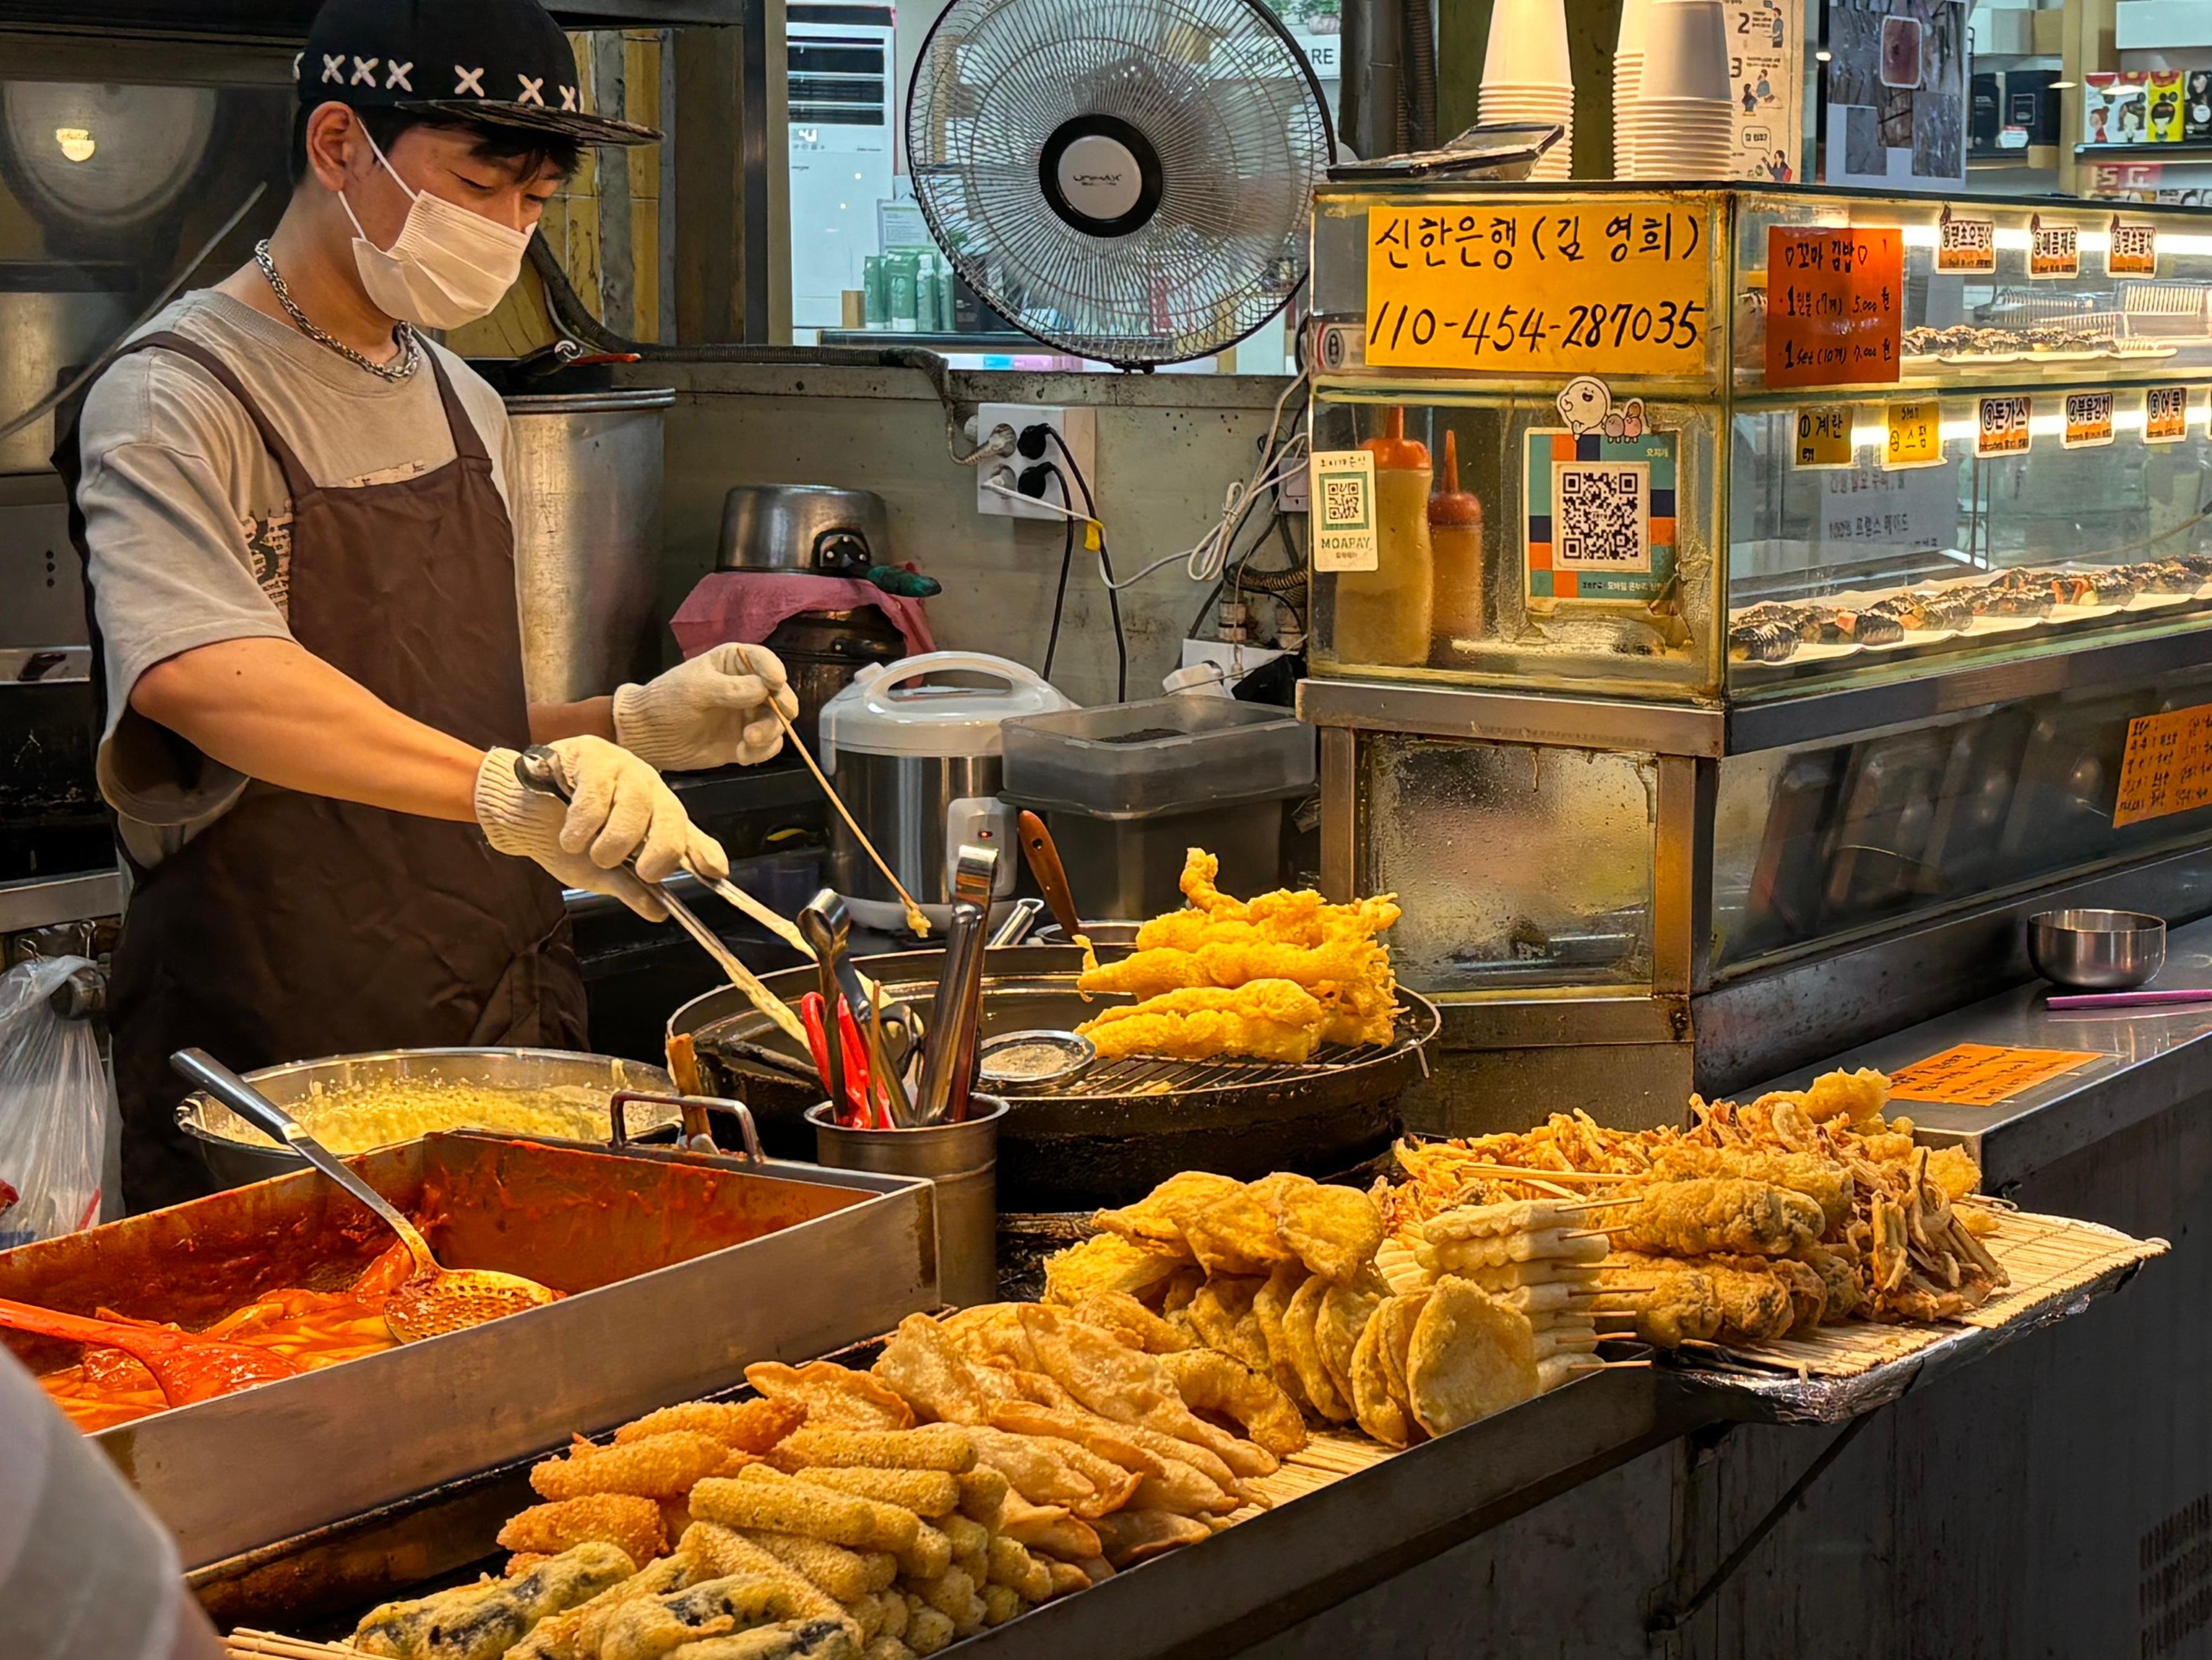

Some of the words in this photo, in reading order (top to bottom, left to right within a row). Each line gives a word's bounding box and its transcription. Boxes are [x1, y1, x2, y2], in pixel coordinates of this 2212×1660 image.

[1737, 12, 1750, 34] 2
[1730, 57, 1743, 78] 3
[1374, 216, 1516, 270] 신한은행
[1797, 241, 1824, 270] 꼬마
[1831, 239, 1854, 273] 김밥
[1368, 300, 1705, 355] 110-454-287035
[1816, 413, 1843, 439] 계란
[1320, 536, 1371, 549] MOAPAY
